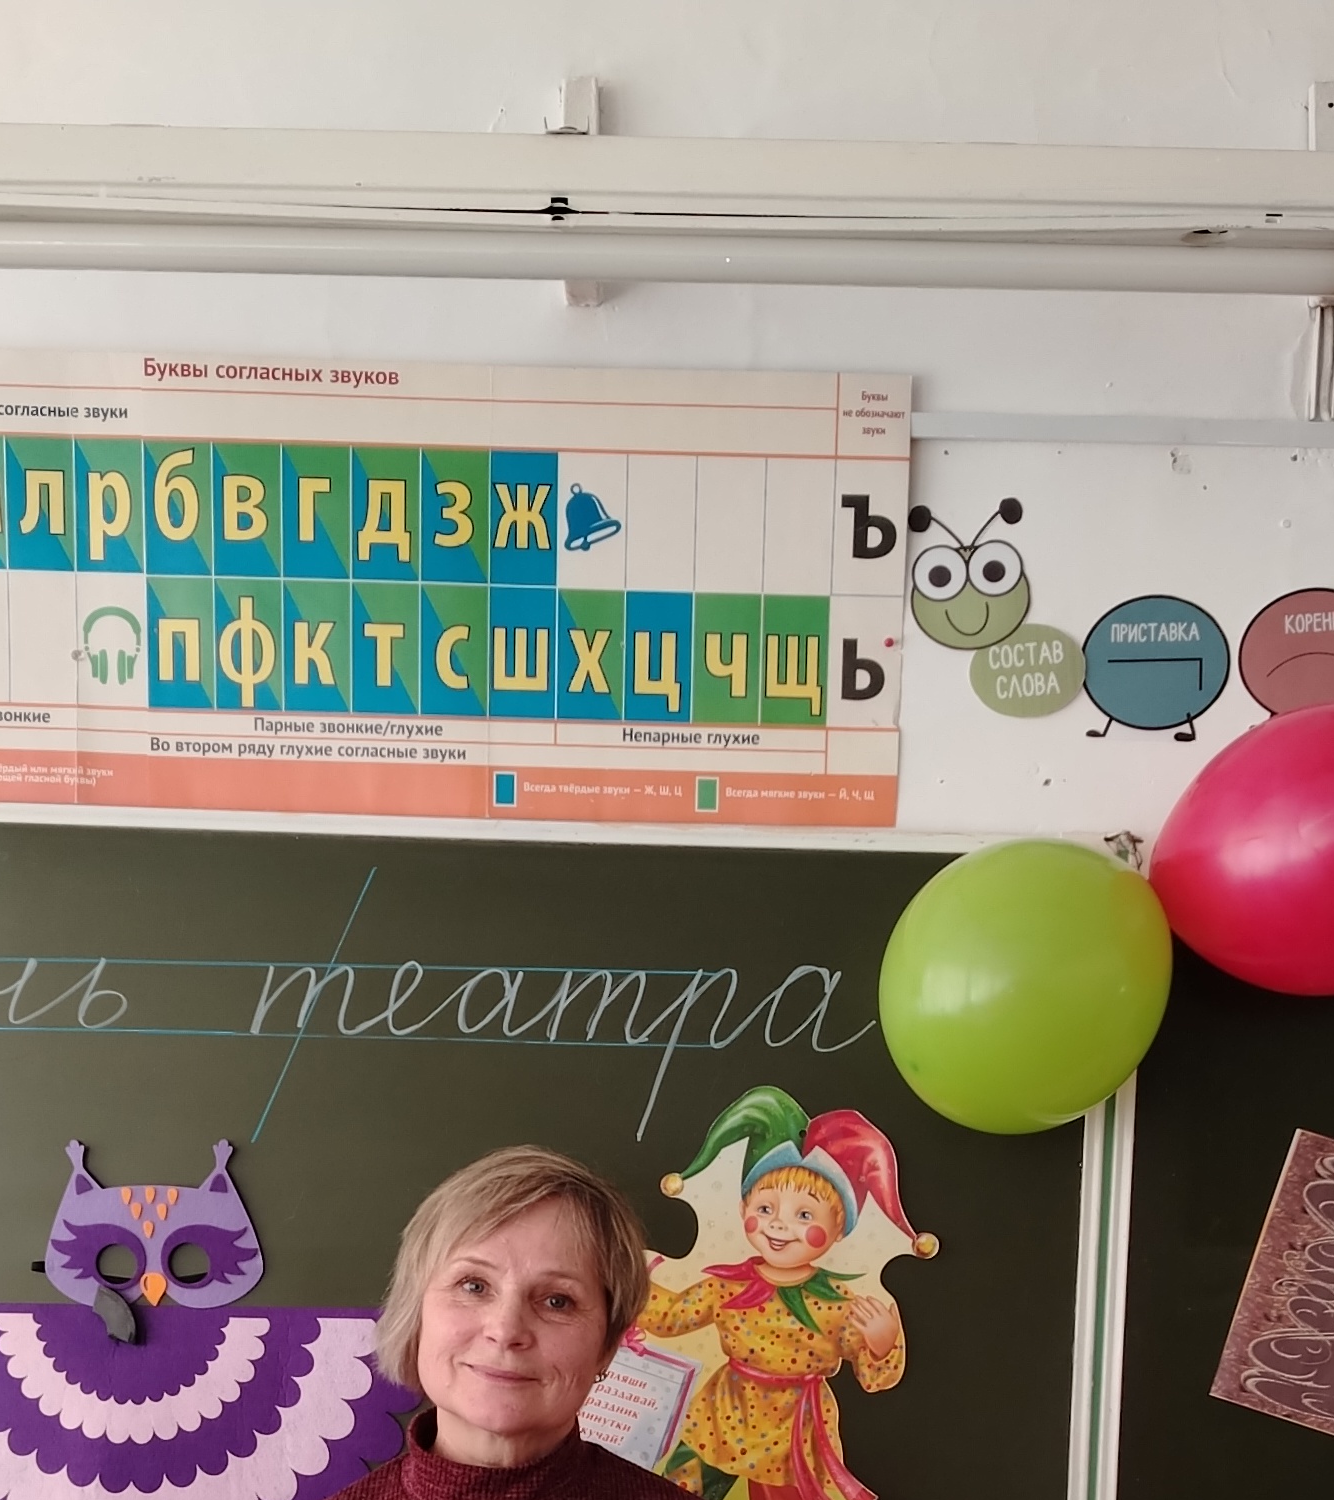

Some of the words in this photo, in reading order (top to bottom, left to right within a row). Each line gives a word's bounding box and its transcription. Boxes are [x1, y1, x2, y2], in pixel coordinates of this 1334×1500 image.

[144, 358, 207, 381] Буквы
[216, 364, 323, 383] согласных
[330, 369, 399, 388] звуков
[862, 391, 888, 403] Буквы
[84, 407, 128, 421] звуки
[856, 408, 905, 419] обозначают
[862, 427, 885, 437] звуки
[1110, 621, 1201, 644] ПРИСТАВКА
[988, 639, 1064, 670] СОСТАВ
[997, 672, 1060, 699] СЛОВА
[254, 717, 314, 734] Парные
[320, 721, 442, 738] звонкие/глухие
[622, 728, 702, 747] Непарные
[707, 731, 760, 747] глухие
[151, 737, 170, 751] Во
[176, 741, 232, 755] втором
[238, 742, 275, 757] ряду
[280, 743, 332, 758] глухие
[338, 744, 417, 759] согласные
[423, 747, 466, 762] звуки
[250, 954, 876, 1142] театра
[584, 1397, 639, 1419] раздник
[595, 1384, 658, 1410] раздавай,
[580, 1427, 624, 1445] кучай!
